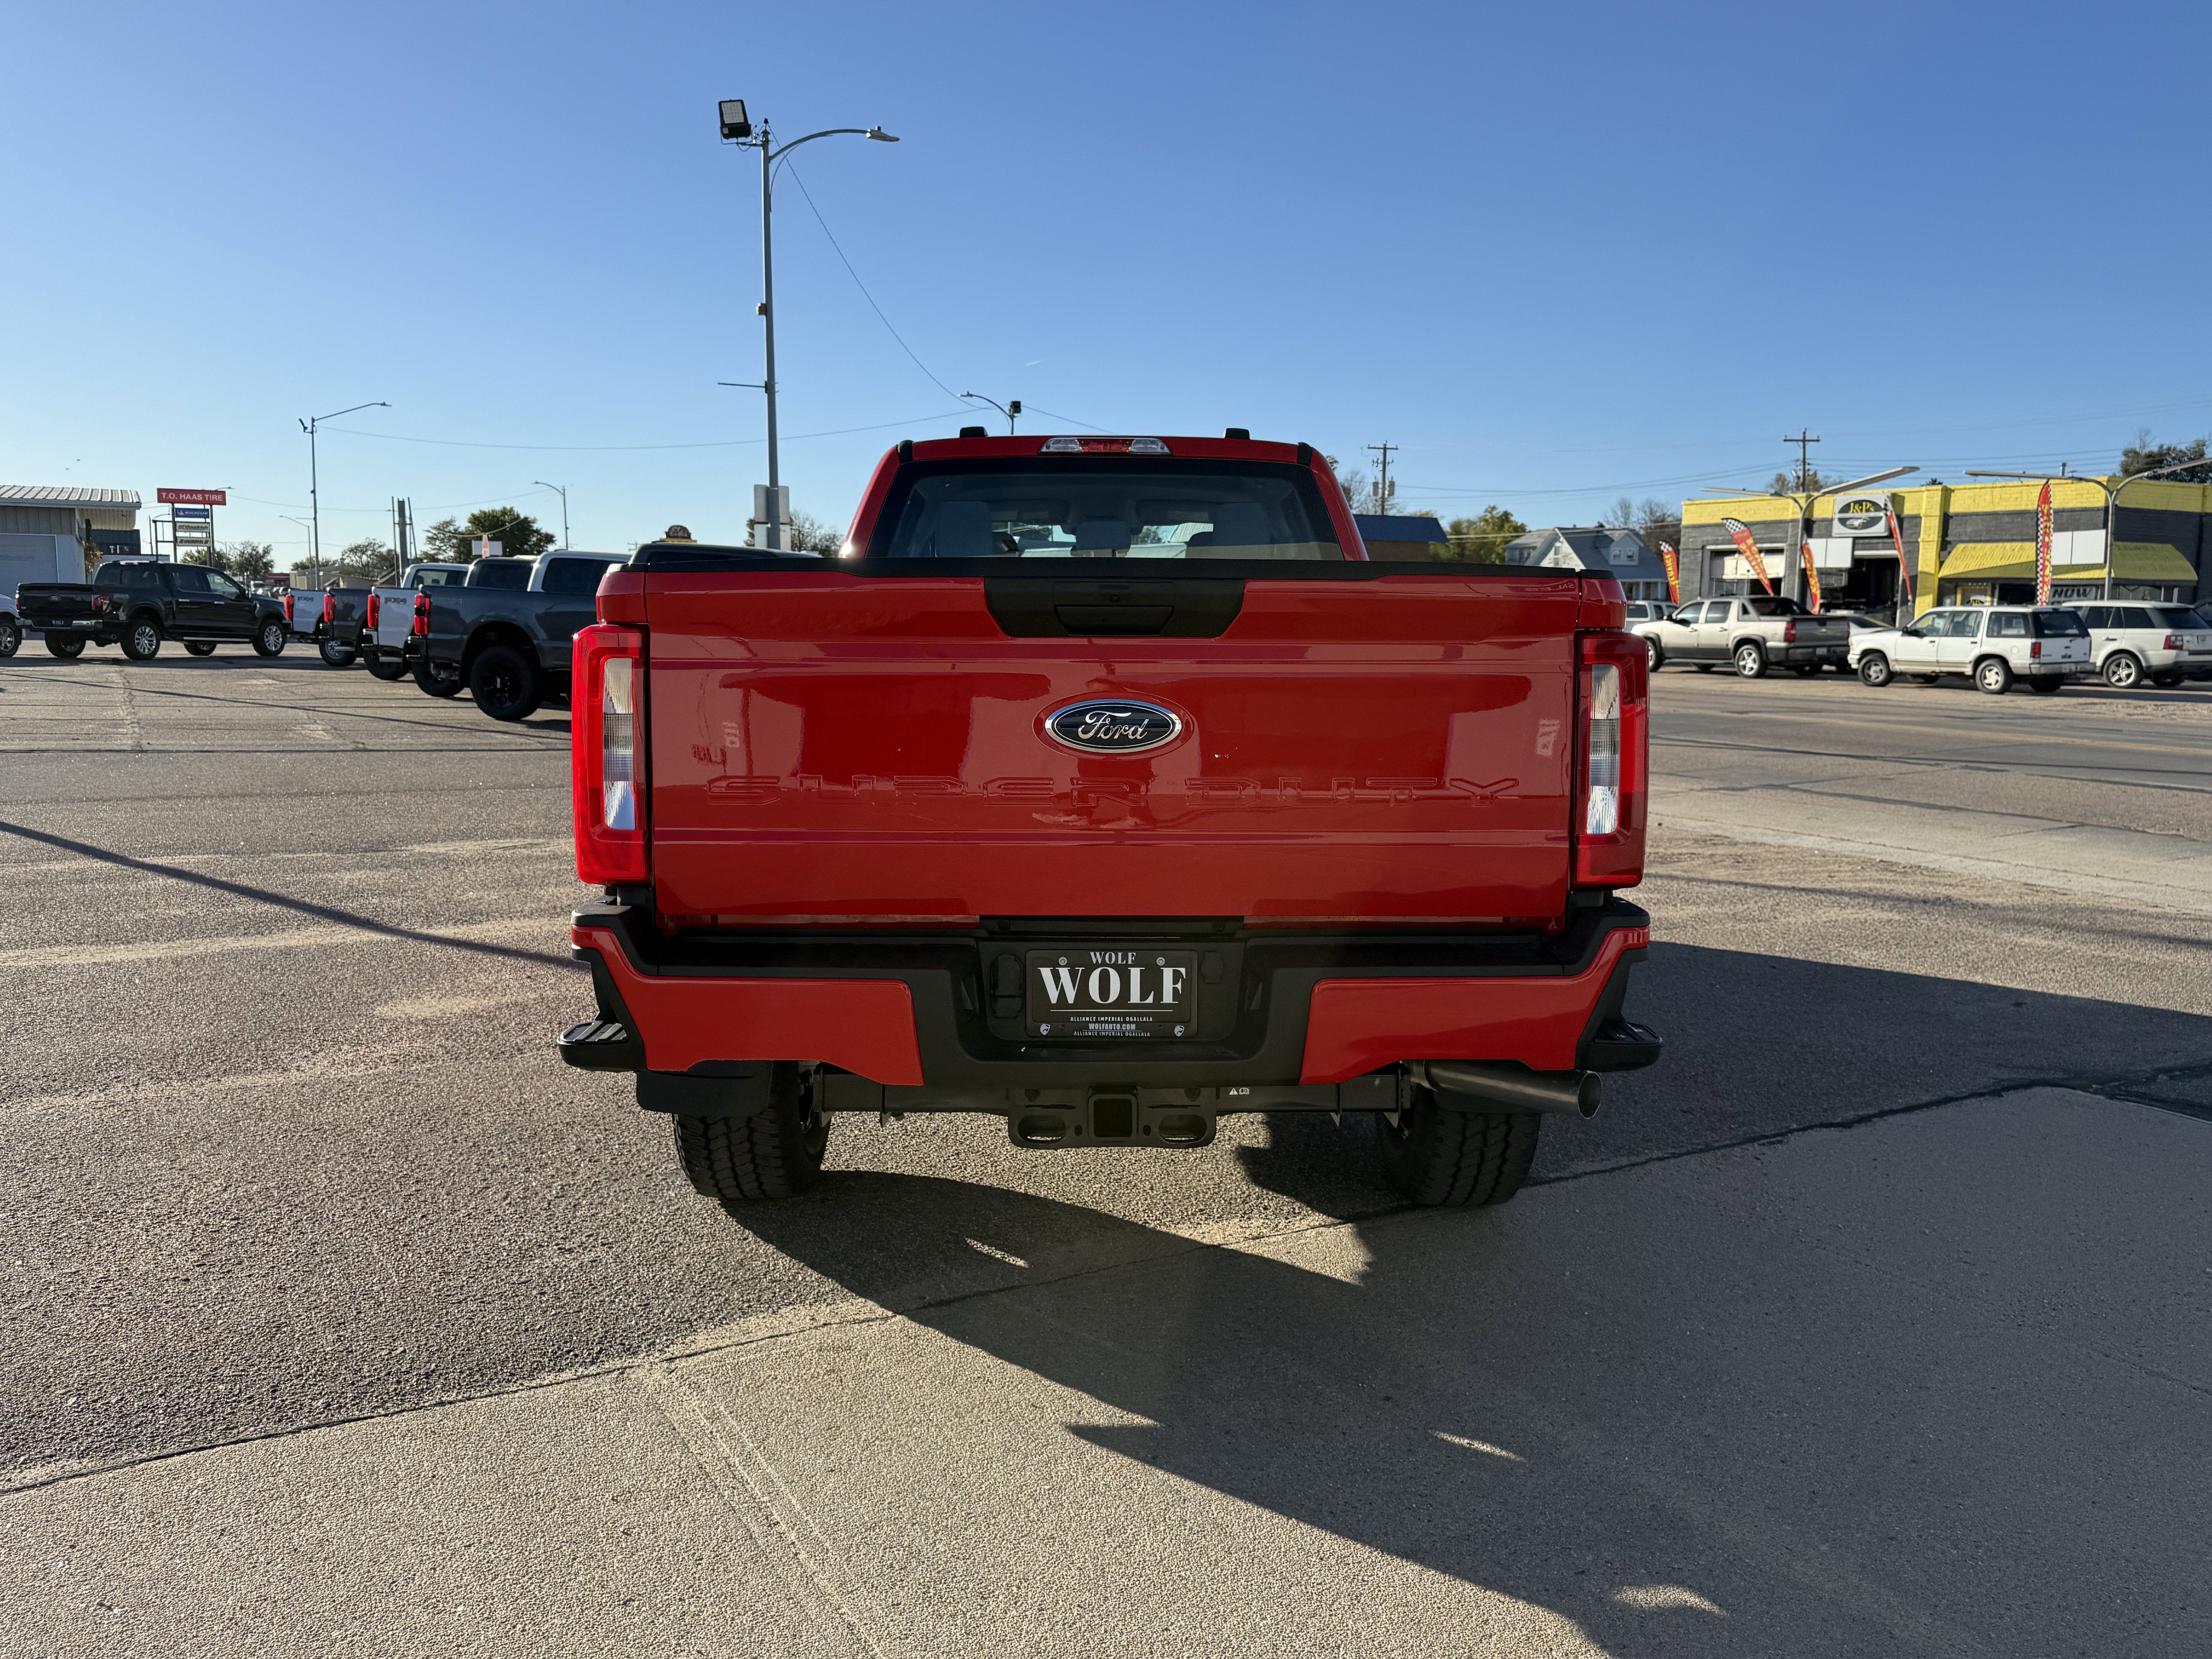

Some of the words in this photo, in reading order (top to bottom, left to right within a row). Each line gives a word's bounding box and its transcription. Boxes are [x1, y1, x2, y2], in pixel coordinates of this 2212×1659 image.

[2052, 587, 2092, 598] NOW
[1077, 710, 1148, 740] Ford
[707, 774, 1146, 807] SUPER
[1185, 777, 1519, 807] DUTY
[1090, 952, 1136, 964] WOLF
[1038, 967, 1186, 1004] WOLF
